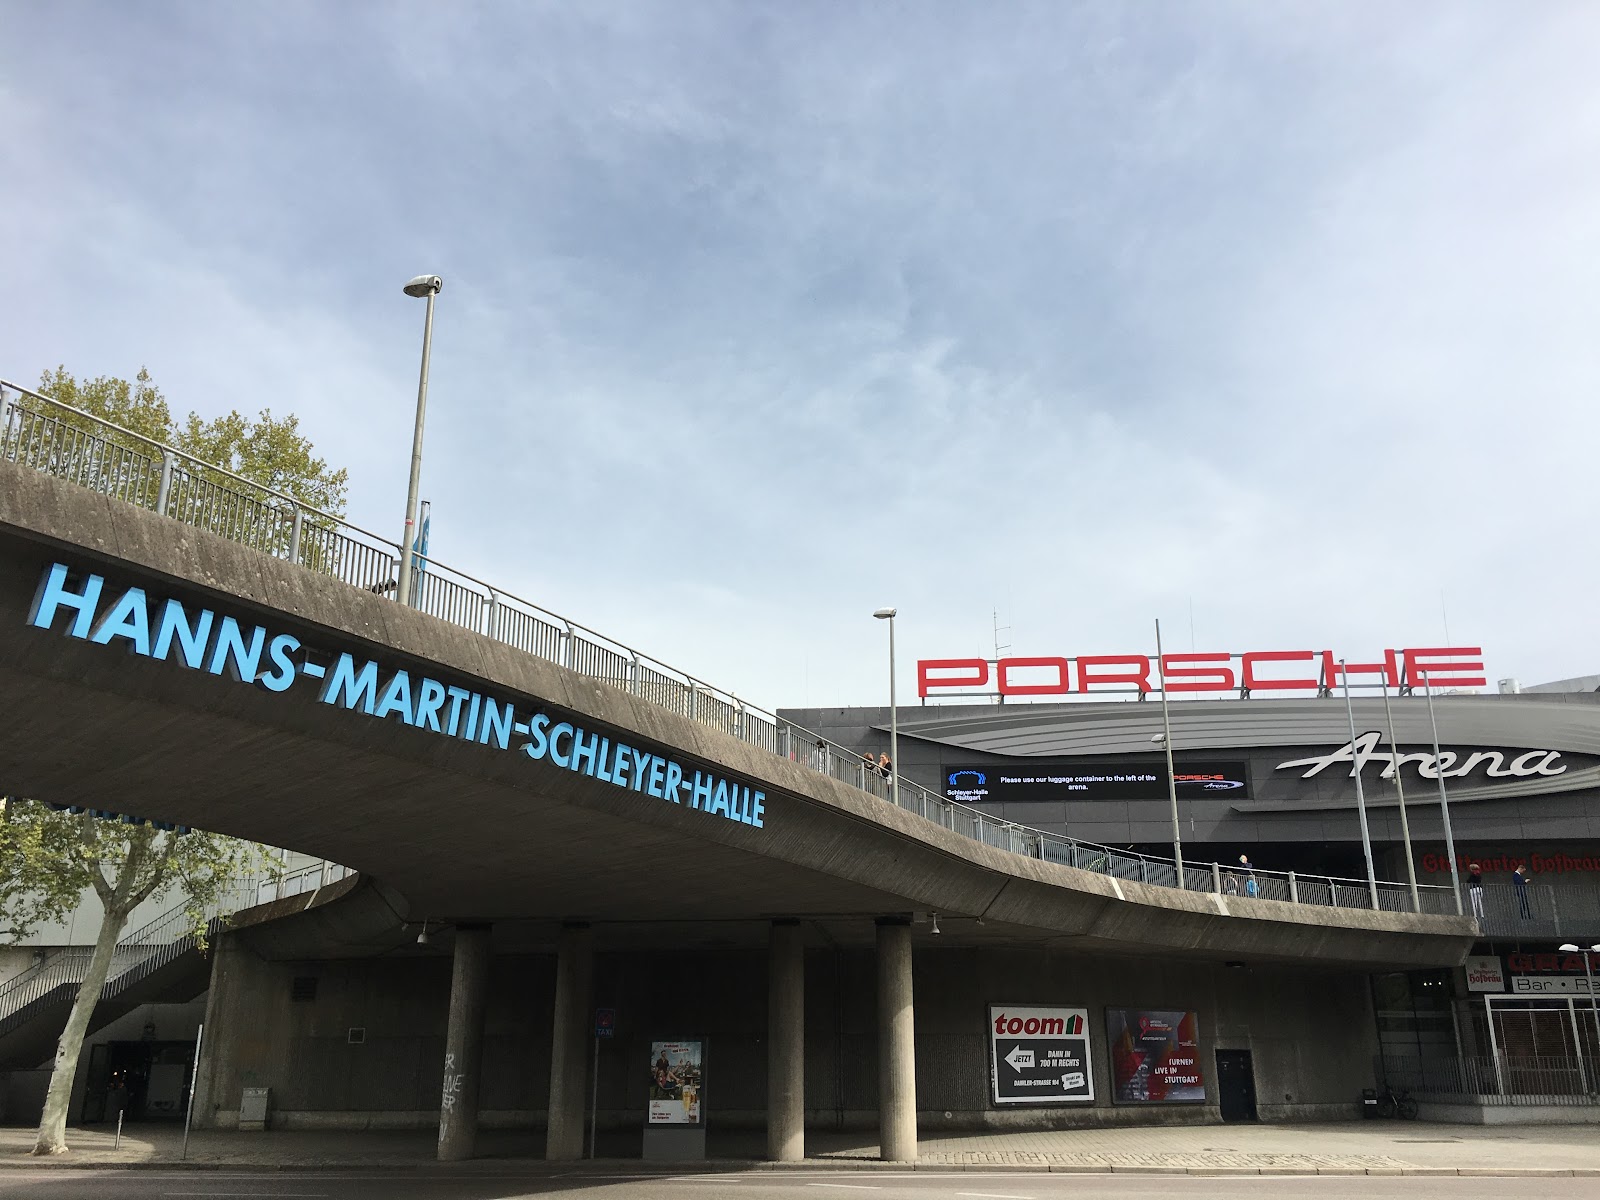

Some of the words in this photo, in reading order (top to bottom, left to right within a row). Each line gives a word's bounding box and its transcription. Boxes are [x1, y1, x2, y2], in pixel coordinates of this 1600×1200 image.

[918, 647, 1486, 697] PORSCHE
[28, 561, 766, 829] HANNS-MARTIN-SCHLEYER-HALLE
[1275, 731, 1567, 779] Arena
[1048, 776, 1073, 785] luggage
[1074, 775, 1105, 783] container
[1125, 774, 1136, 782] left
[1517, 978, 1553, 990] Bar
[995, 1013, 1064, 1035] toom
[1013, 1055, 1031, 1063] JETZT
[1047, 1050, 1064, 1058] DANN
[1064, 1050, 1071, 1058] IN
[1040, 1059, 1051, 1067] 700
[1052, 1059, 1057, 1067] M
[1058, 1058, 1080, 1067] RECHTS
[1168, 1058, 1194, 1066] TURNEN
[1154, 1067, 1168, 1075] LIVE
[1164, 1076, 1198, 1084] STUTTGART
